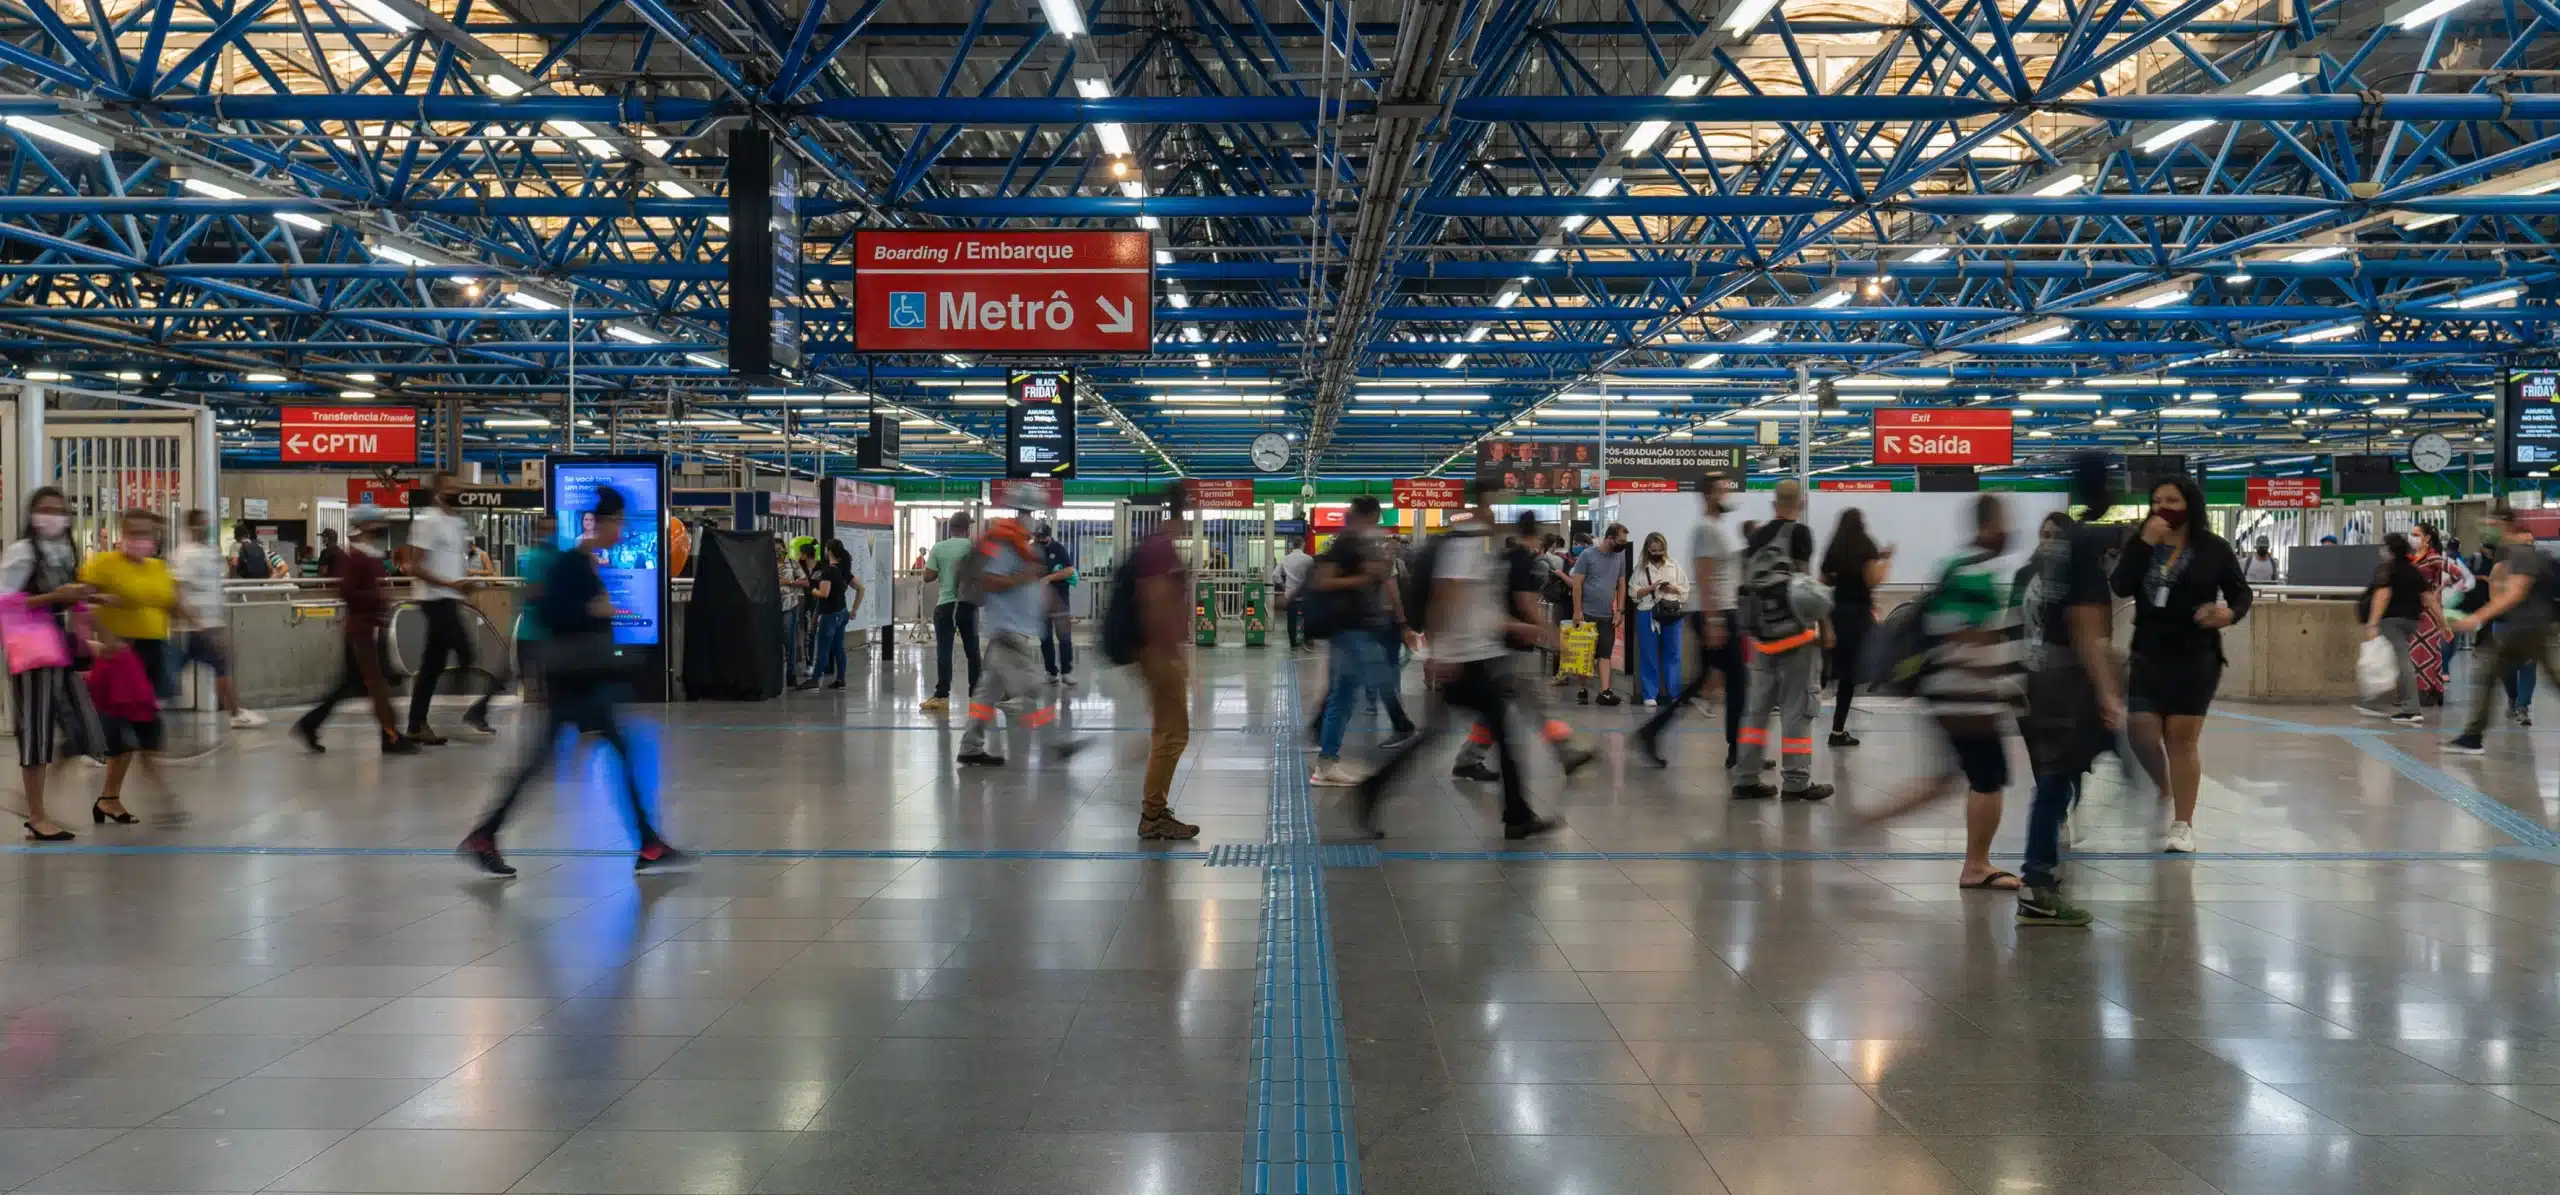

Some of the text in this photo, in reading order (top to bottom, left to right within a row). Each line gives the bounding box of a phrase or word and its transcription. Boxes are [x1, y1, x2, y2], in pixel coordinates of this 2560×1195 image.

[874, 242, 1073, 263] Boarding / Embarque
[939, 290, 1074, 331] Metrô
[1036, 378, 1056, 386] BLACK
[2534, 377, 2555, 385] BLACK
[1025, 386, 1057, 398] FRIDAY
[2523, 386, 2556, 397] FRIDAY
[312, 412, 378, 421] Transferência
[1911, 414, 1930, 422] Exit
[312, 433, 377, 453] CPTM
[1909, 434, 1971, 454] Saída
[1675, 449, 1697, 457] 100%
[1699, 449, 1729, 457] ONLINE
[1605, 457, 1622, 465] COM
[1637, 458, 1681, 466] MELHORES
[1697, 459, 1729, 467] DIREITO
[1200, 490, 1234, 498] Terminal
[1426, 490, 1440, 499] Mq.
[459, 493, 501, 505] CPTM
[1199, 499, 1242, 507] Rodoviário
[1411, 499, 1458, 508] São Vicente
[2258, 499, 2304, 507] Urbano Sul
